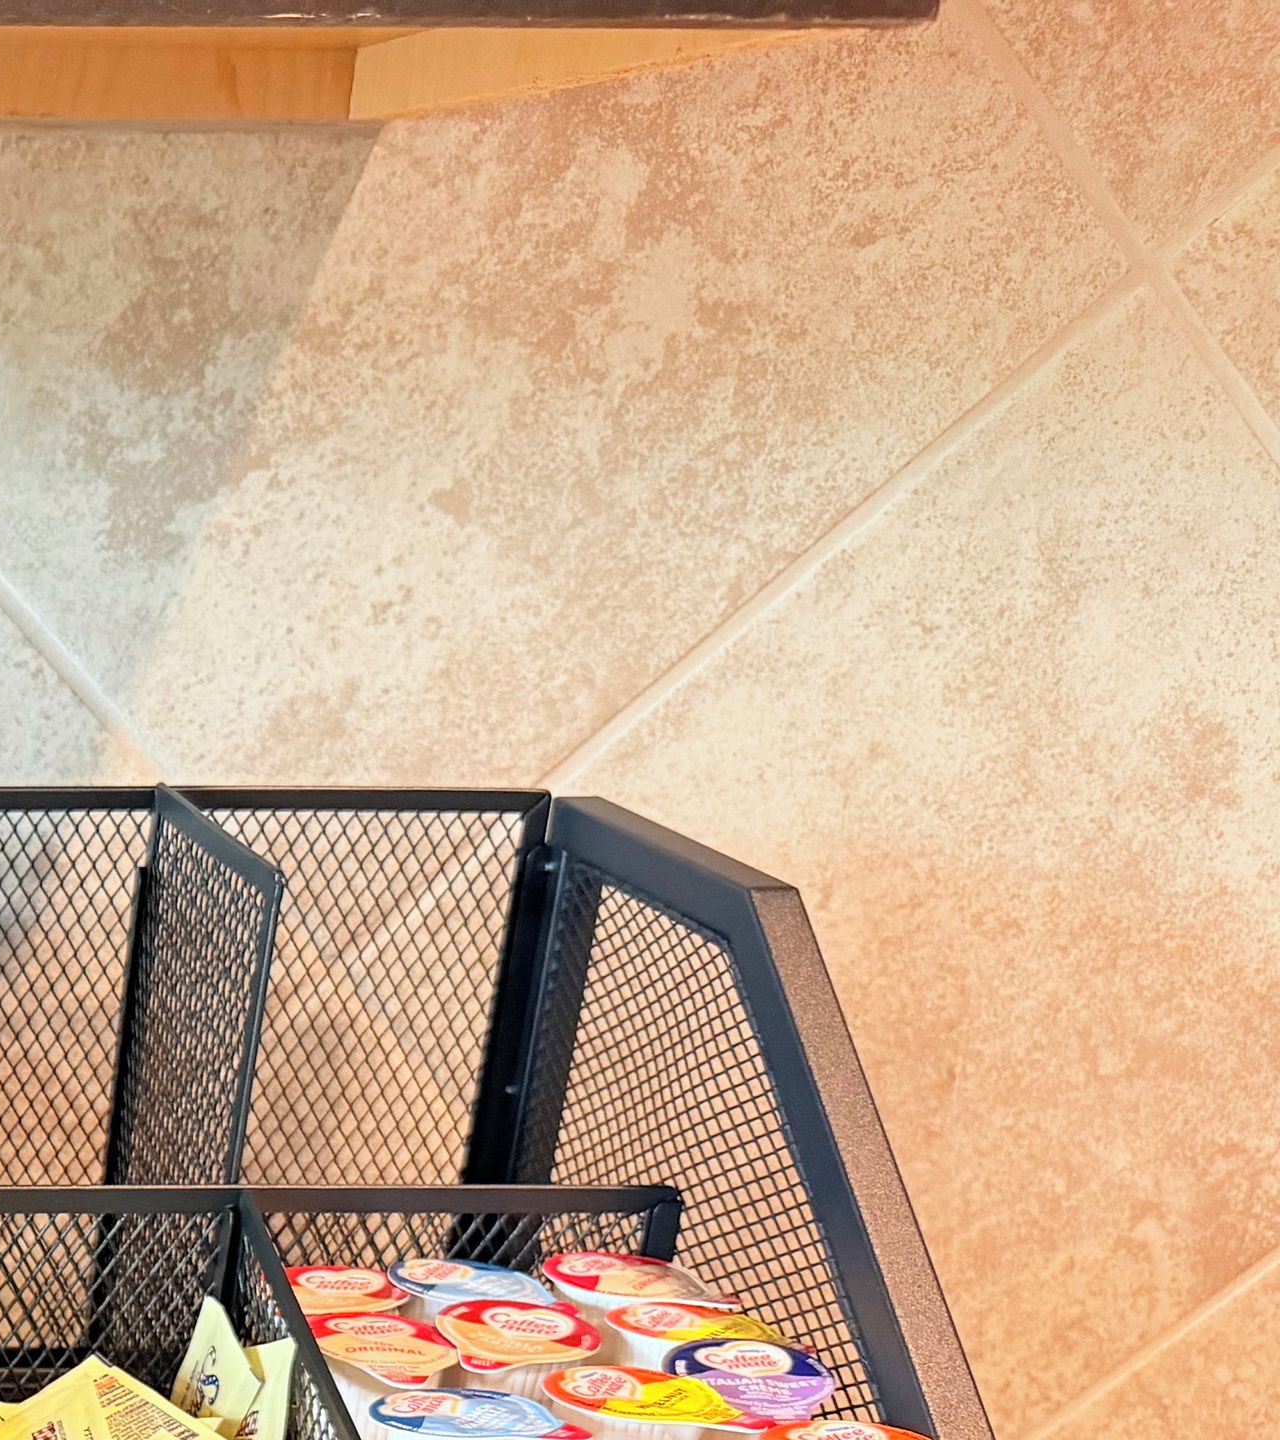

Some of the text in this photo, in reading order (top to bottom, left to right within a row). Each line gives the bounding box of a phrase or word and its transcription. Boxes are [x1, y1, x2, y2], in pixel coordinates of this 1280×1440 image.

[489, 1310, 561, 1331] Coffee
[500, 1323, 558, 1336] mate
[344, 1345, 427, 1357] ORIGINAL
[704, 1353, 772, 1365] Coffee
